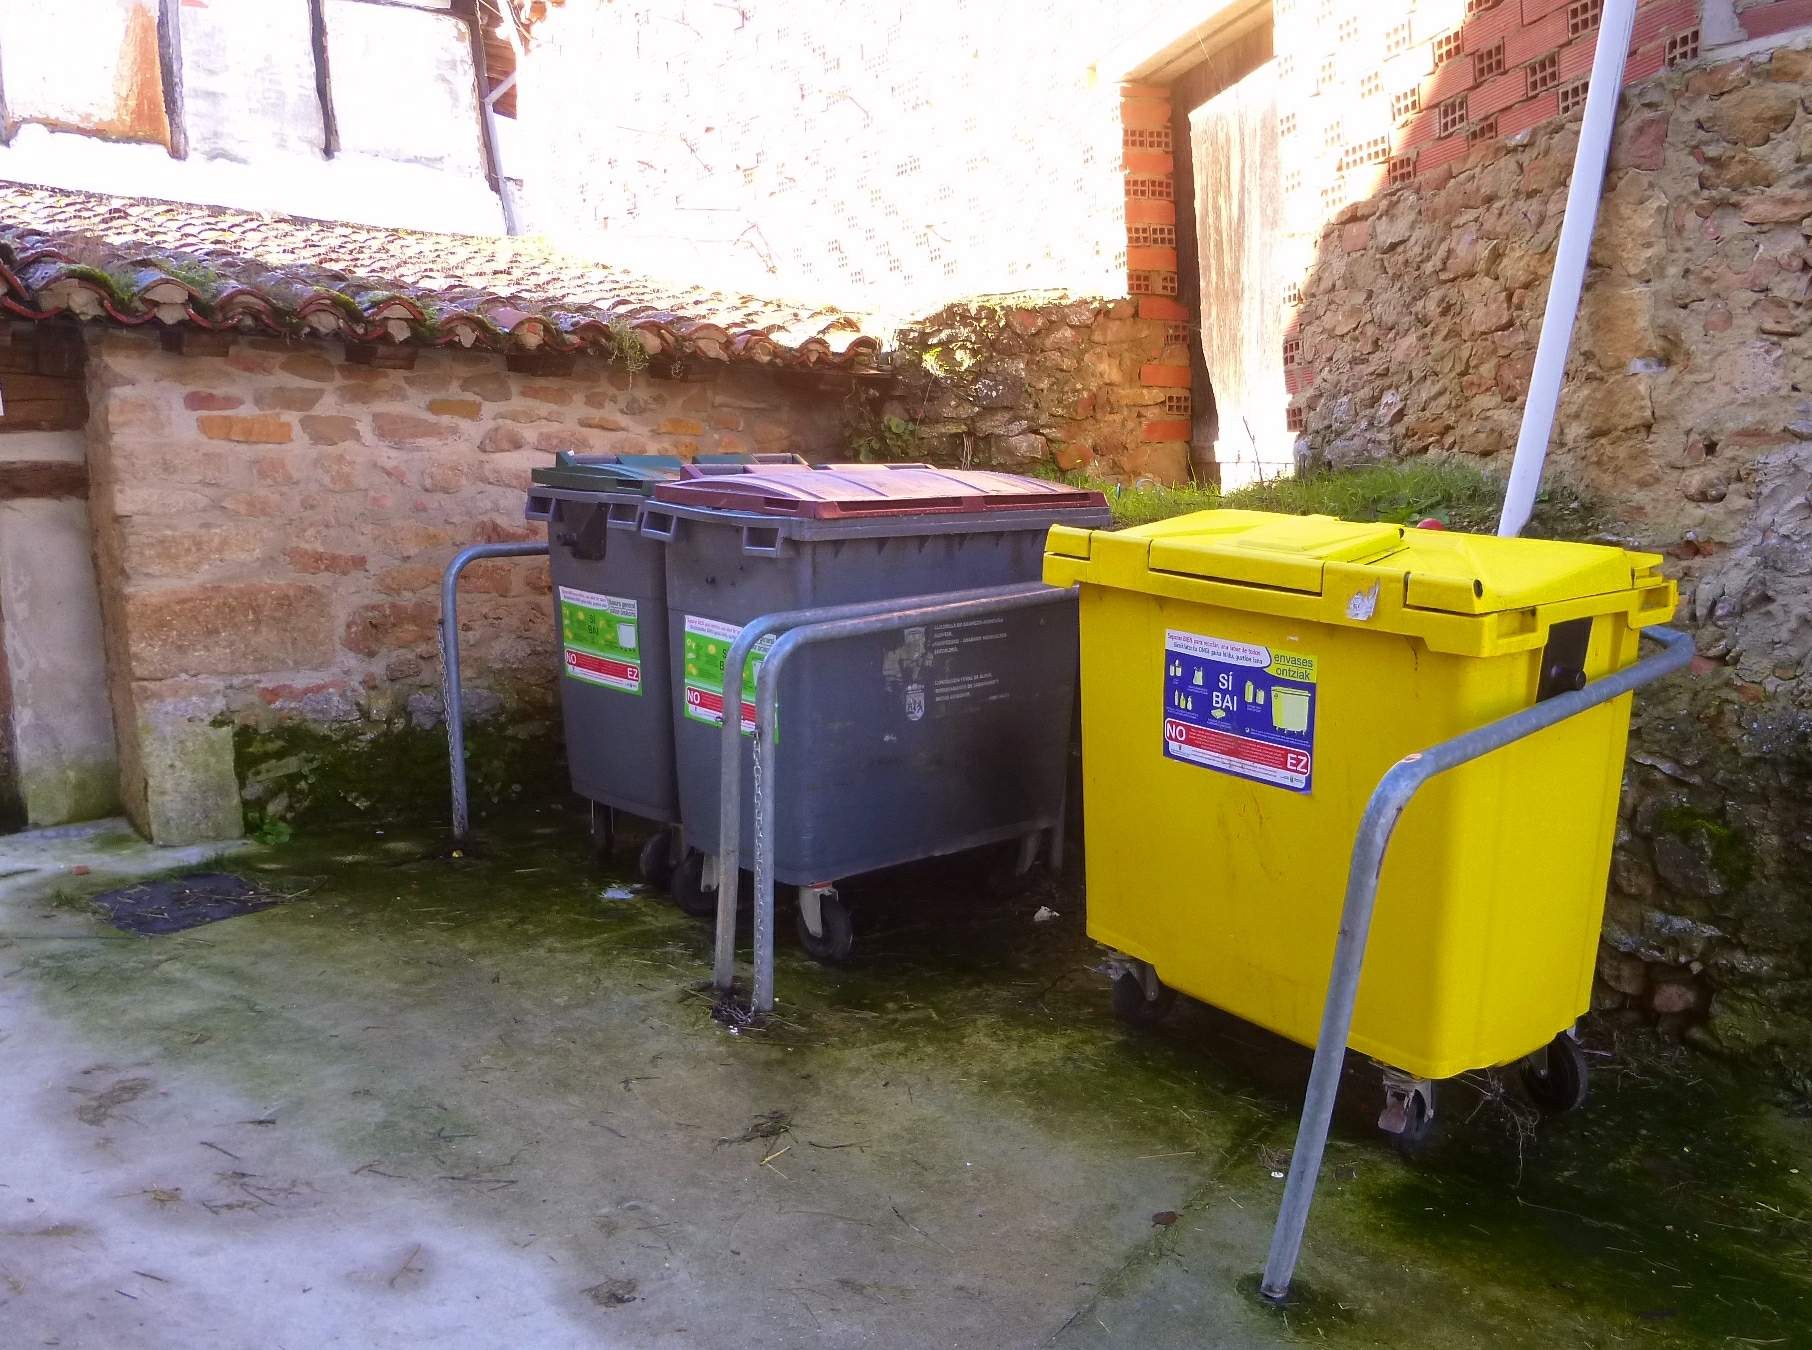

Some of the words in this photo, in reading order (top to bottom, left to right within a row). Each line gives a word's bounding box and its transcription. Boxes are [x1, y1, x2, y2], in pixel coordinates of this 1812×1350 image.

[566, 653, 577, 664] NO
[1274, 653, 1313, 669] envases
[627, 668, 639, 680] EZ
[1218, 672, 1232, 691] SÍ
[1275, 666, 1311, 681] ontziak
[687, 690, 700, 704] NO
[1212, 691, 1237, 711] BAI
[1166, 722, 1186, 741] NO
[1286, 753, 1308, 772] EZ
